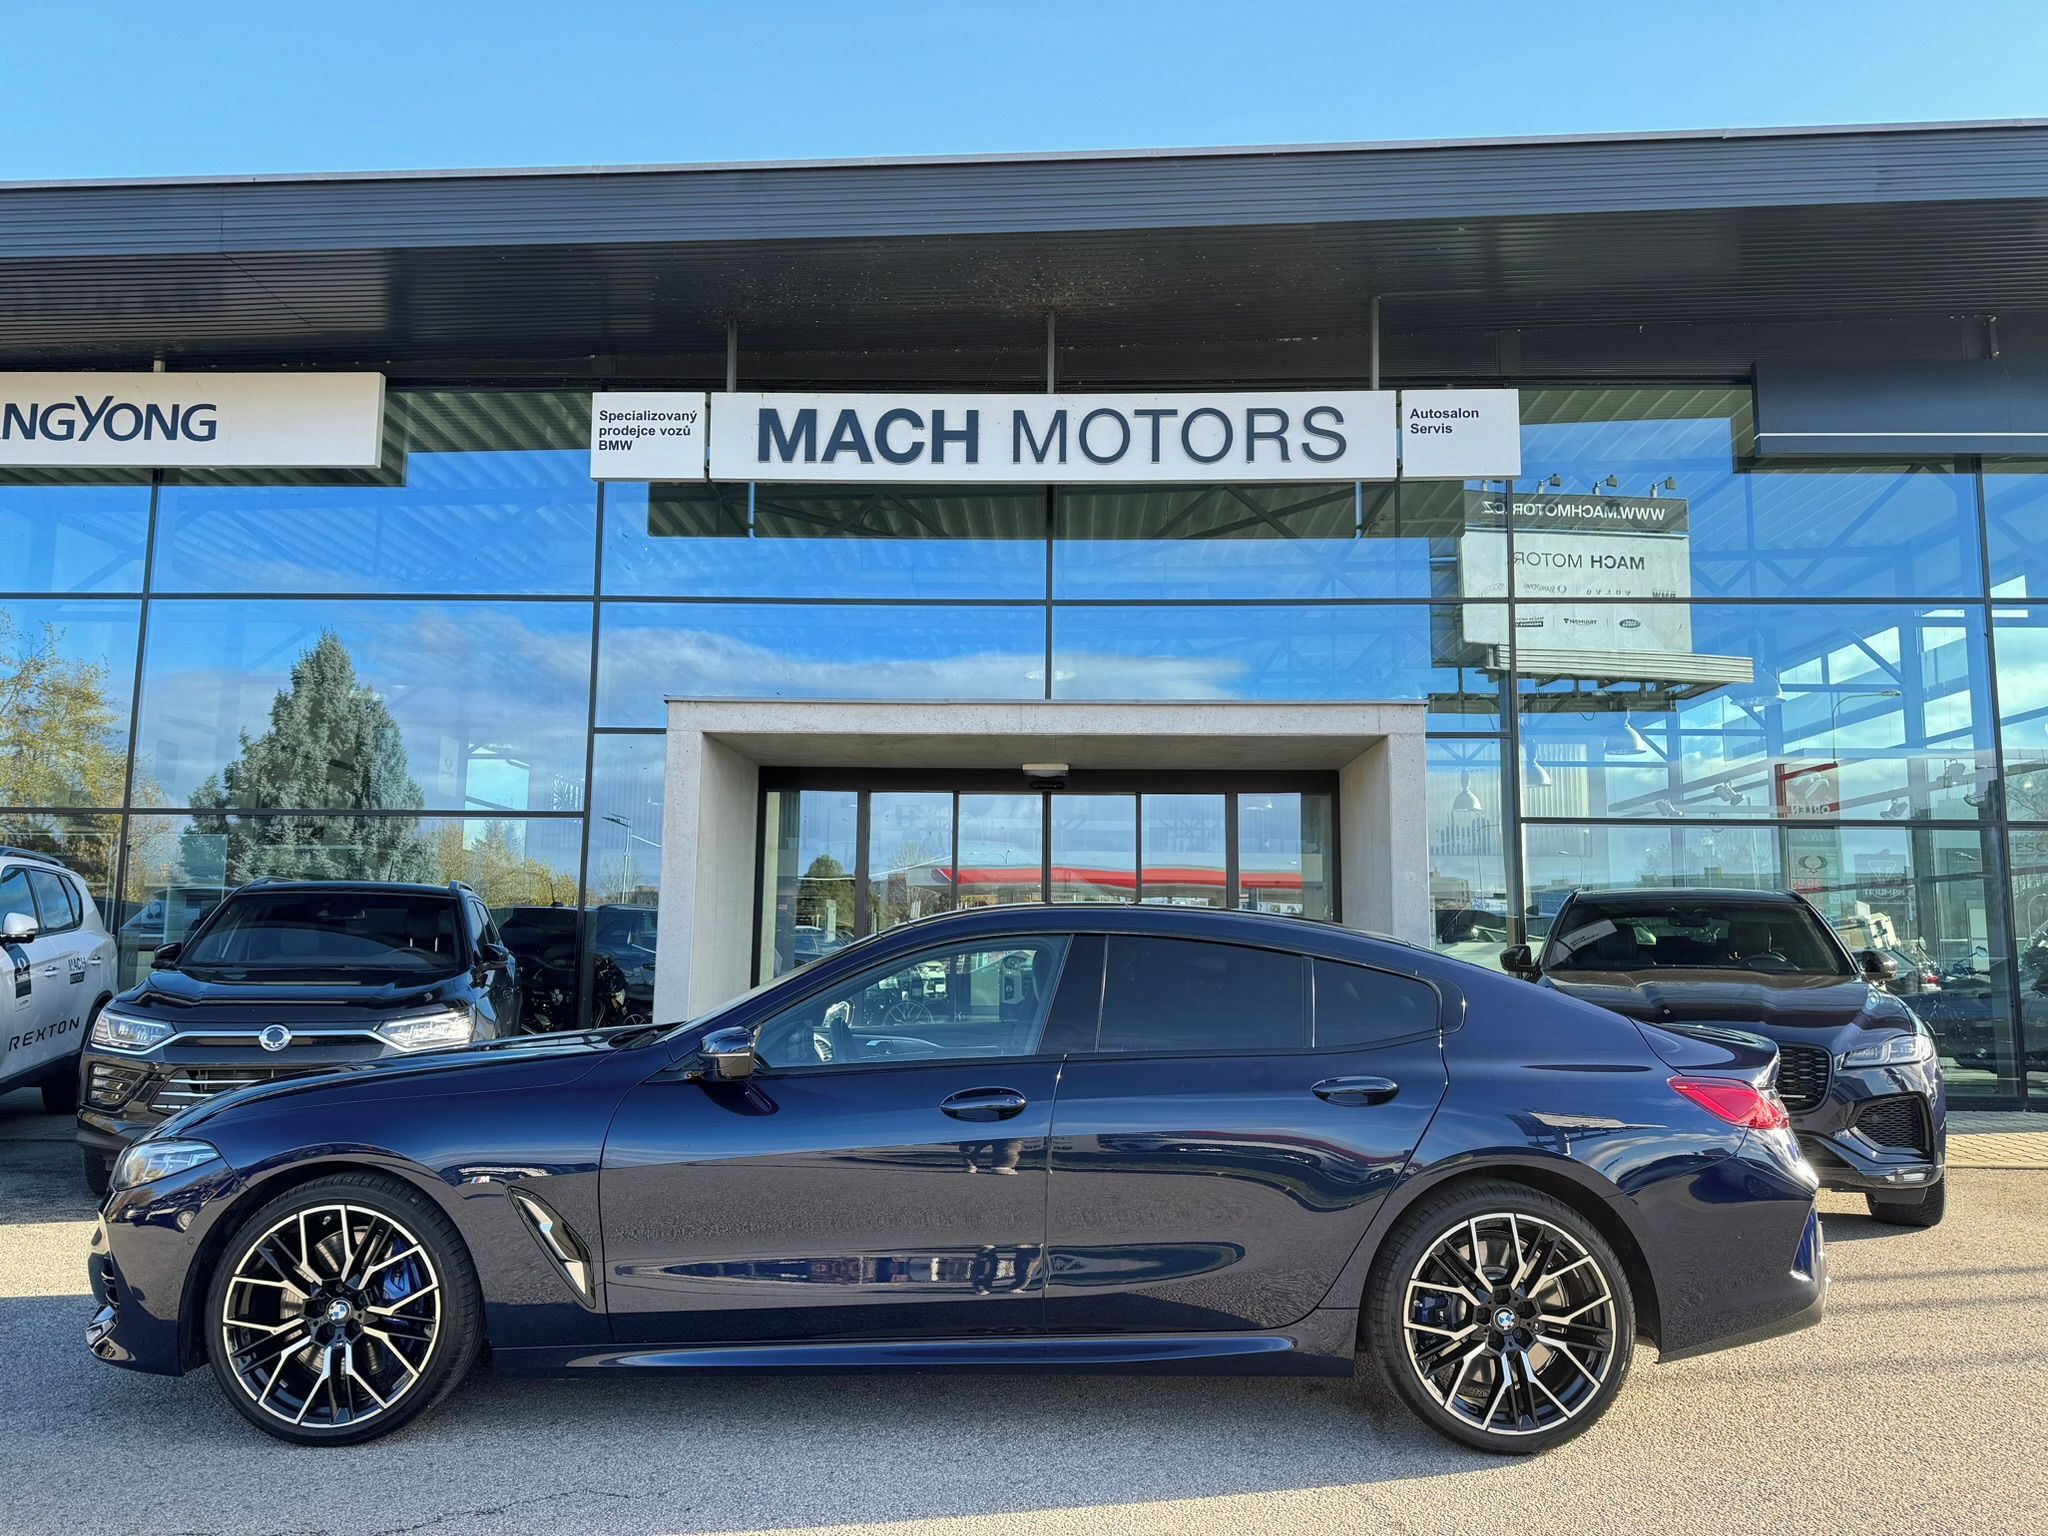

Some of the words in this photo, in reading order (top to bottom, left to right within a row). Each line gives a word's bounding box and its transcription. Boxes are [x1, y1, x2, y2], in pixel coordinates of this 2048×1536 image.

[0, 395, 217, 442] NGYONG
[599, 410, 697, 424] Specializovaný
[1409, 407, 1480, 419] Autosalon
[599, 425, 656, 438] prodejce
[660, 425, 691, 436] vozů
[1410, 423, 1453, 434] Servis
[758, 408, 980, 466] MACH
[1012, 406, 1348, 466] MOTORS
[598, 440, 633, 451] BMW
[1863, 887, 1905, 897] TRIUMPH
[8, 1016, 81, 1052] REXTON
